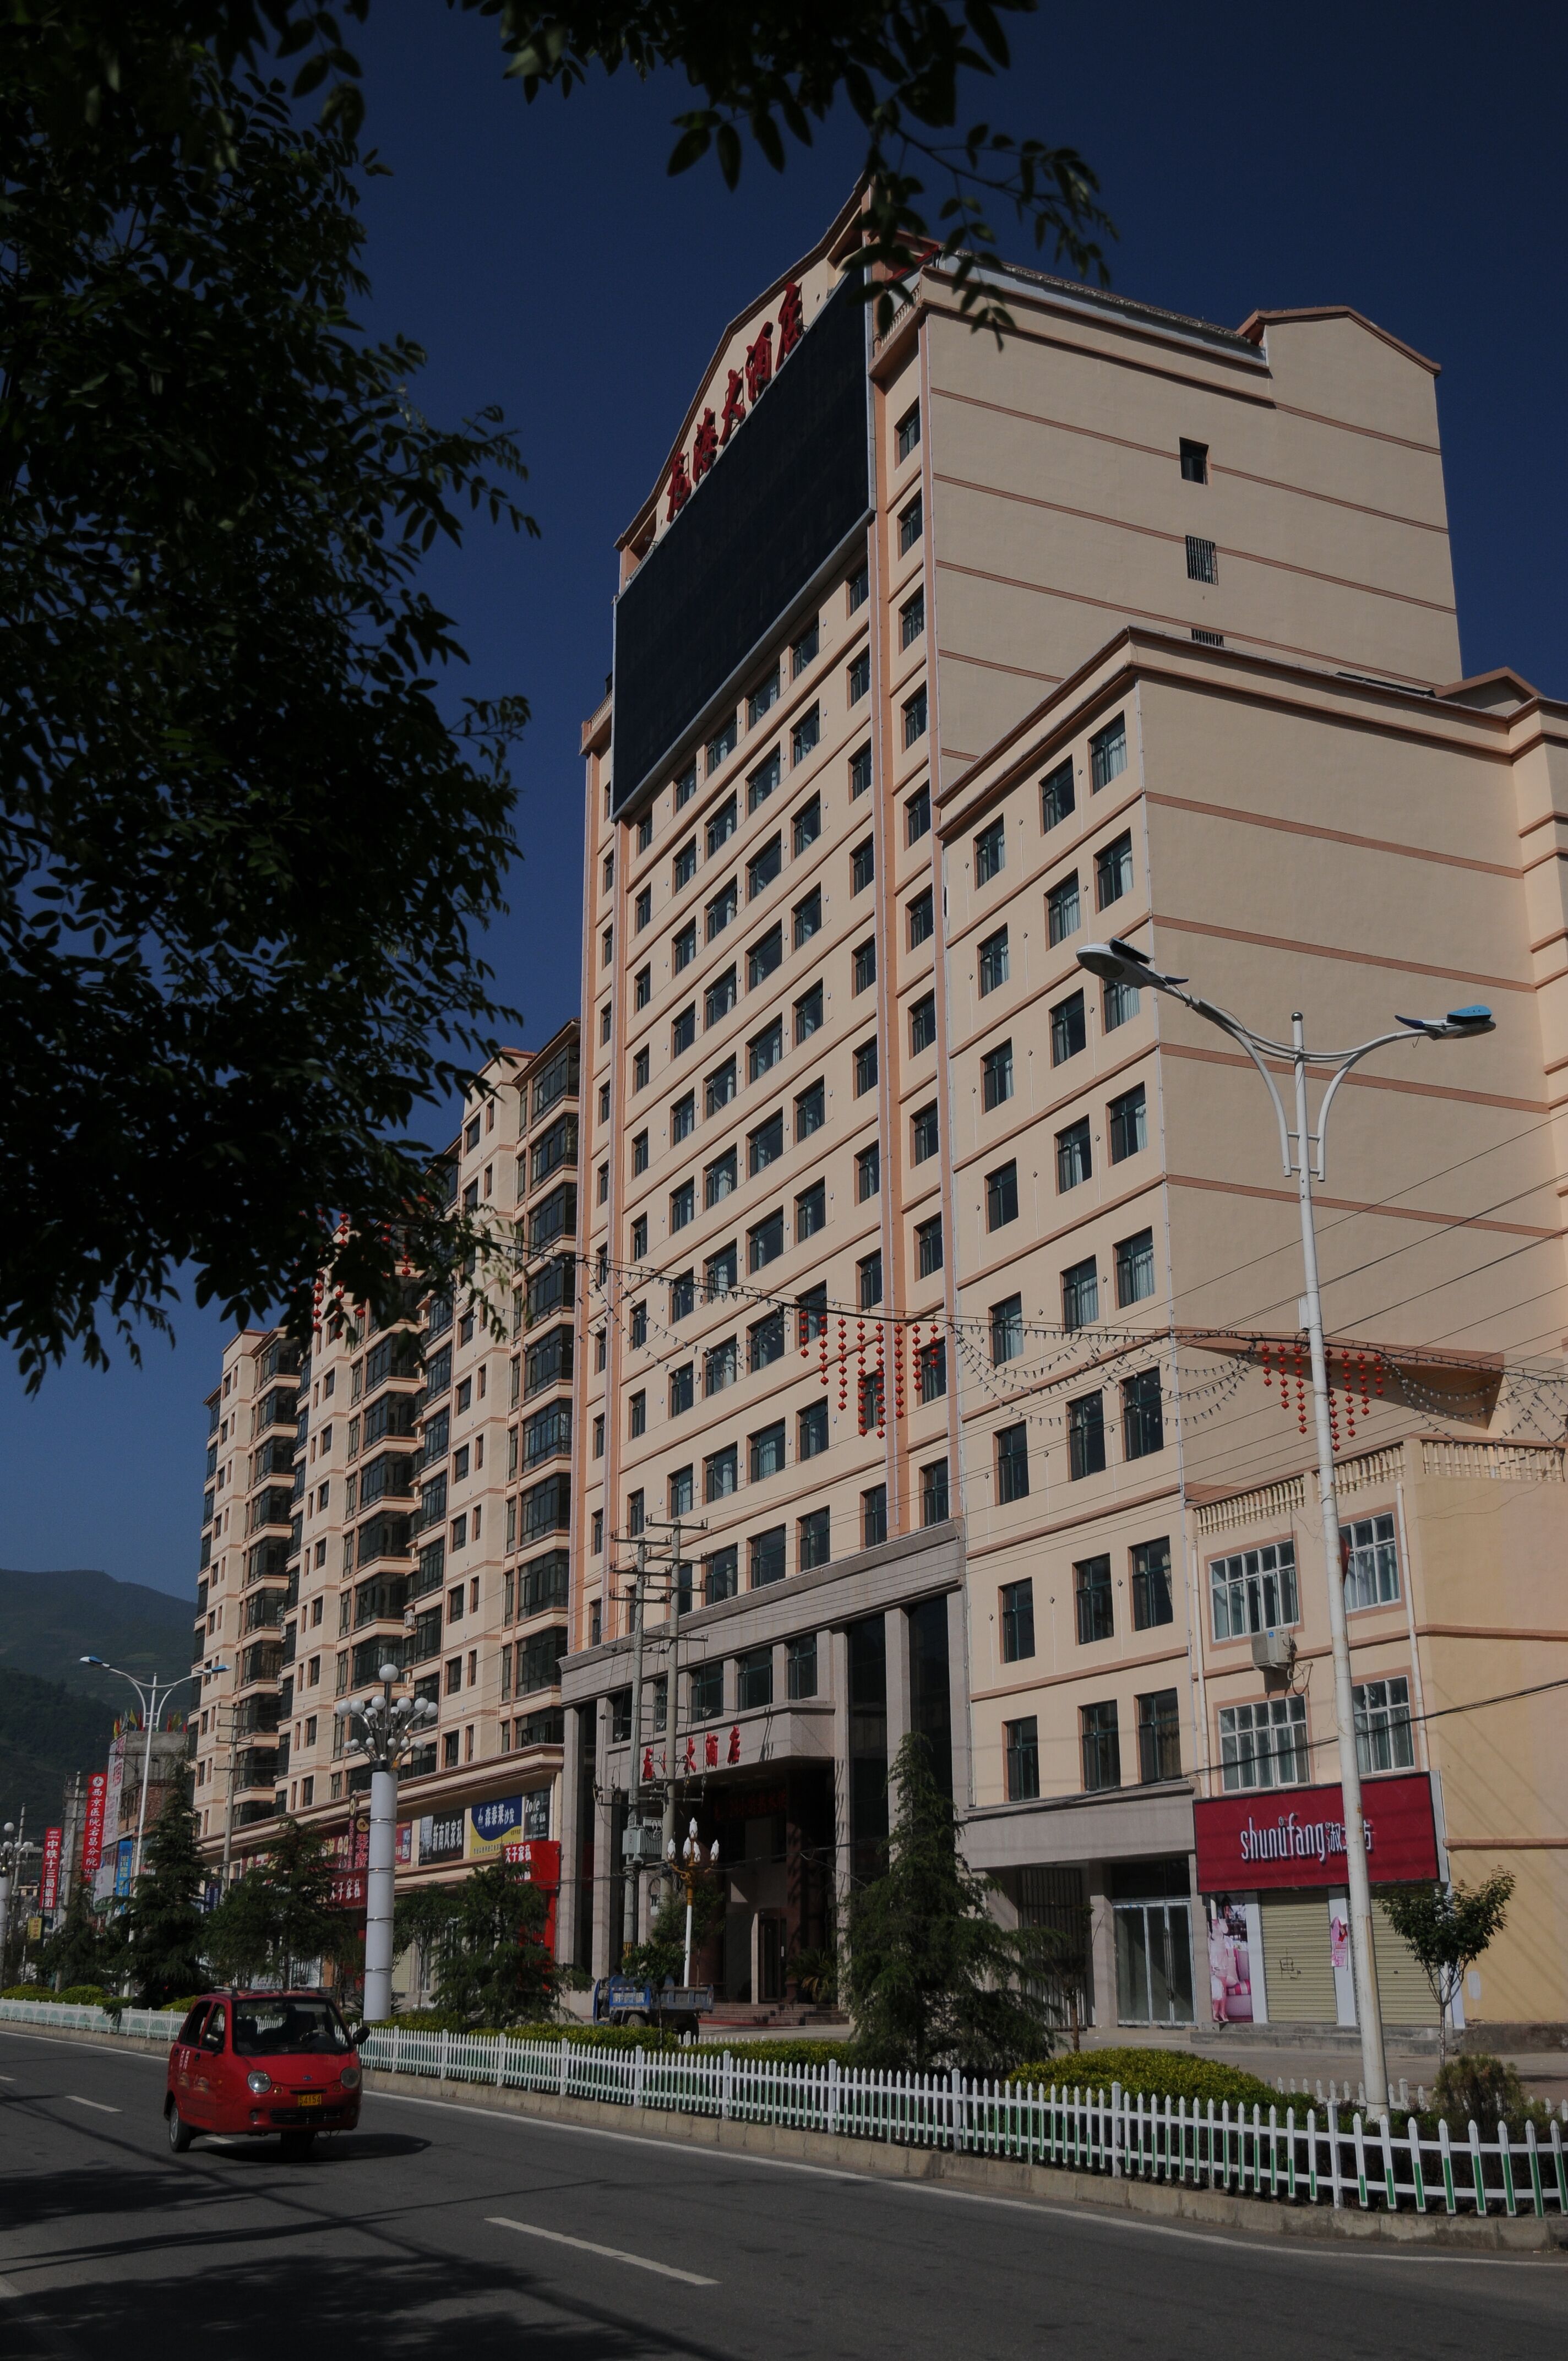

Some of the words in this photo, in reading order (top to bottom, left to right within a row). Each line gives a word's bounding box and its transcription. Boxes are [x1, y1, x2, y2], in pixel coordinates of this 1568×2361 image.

[85, 1788, 103, 1866] 西京医院宕昌分院
[42, 1840, 59, 1908] 中铁十三局集团
